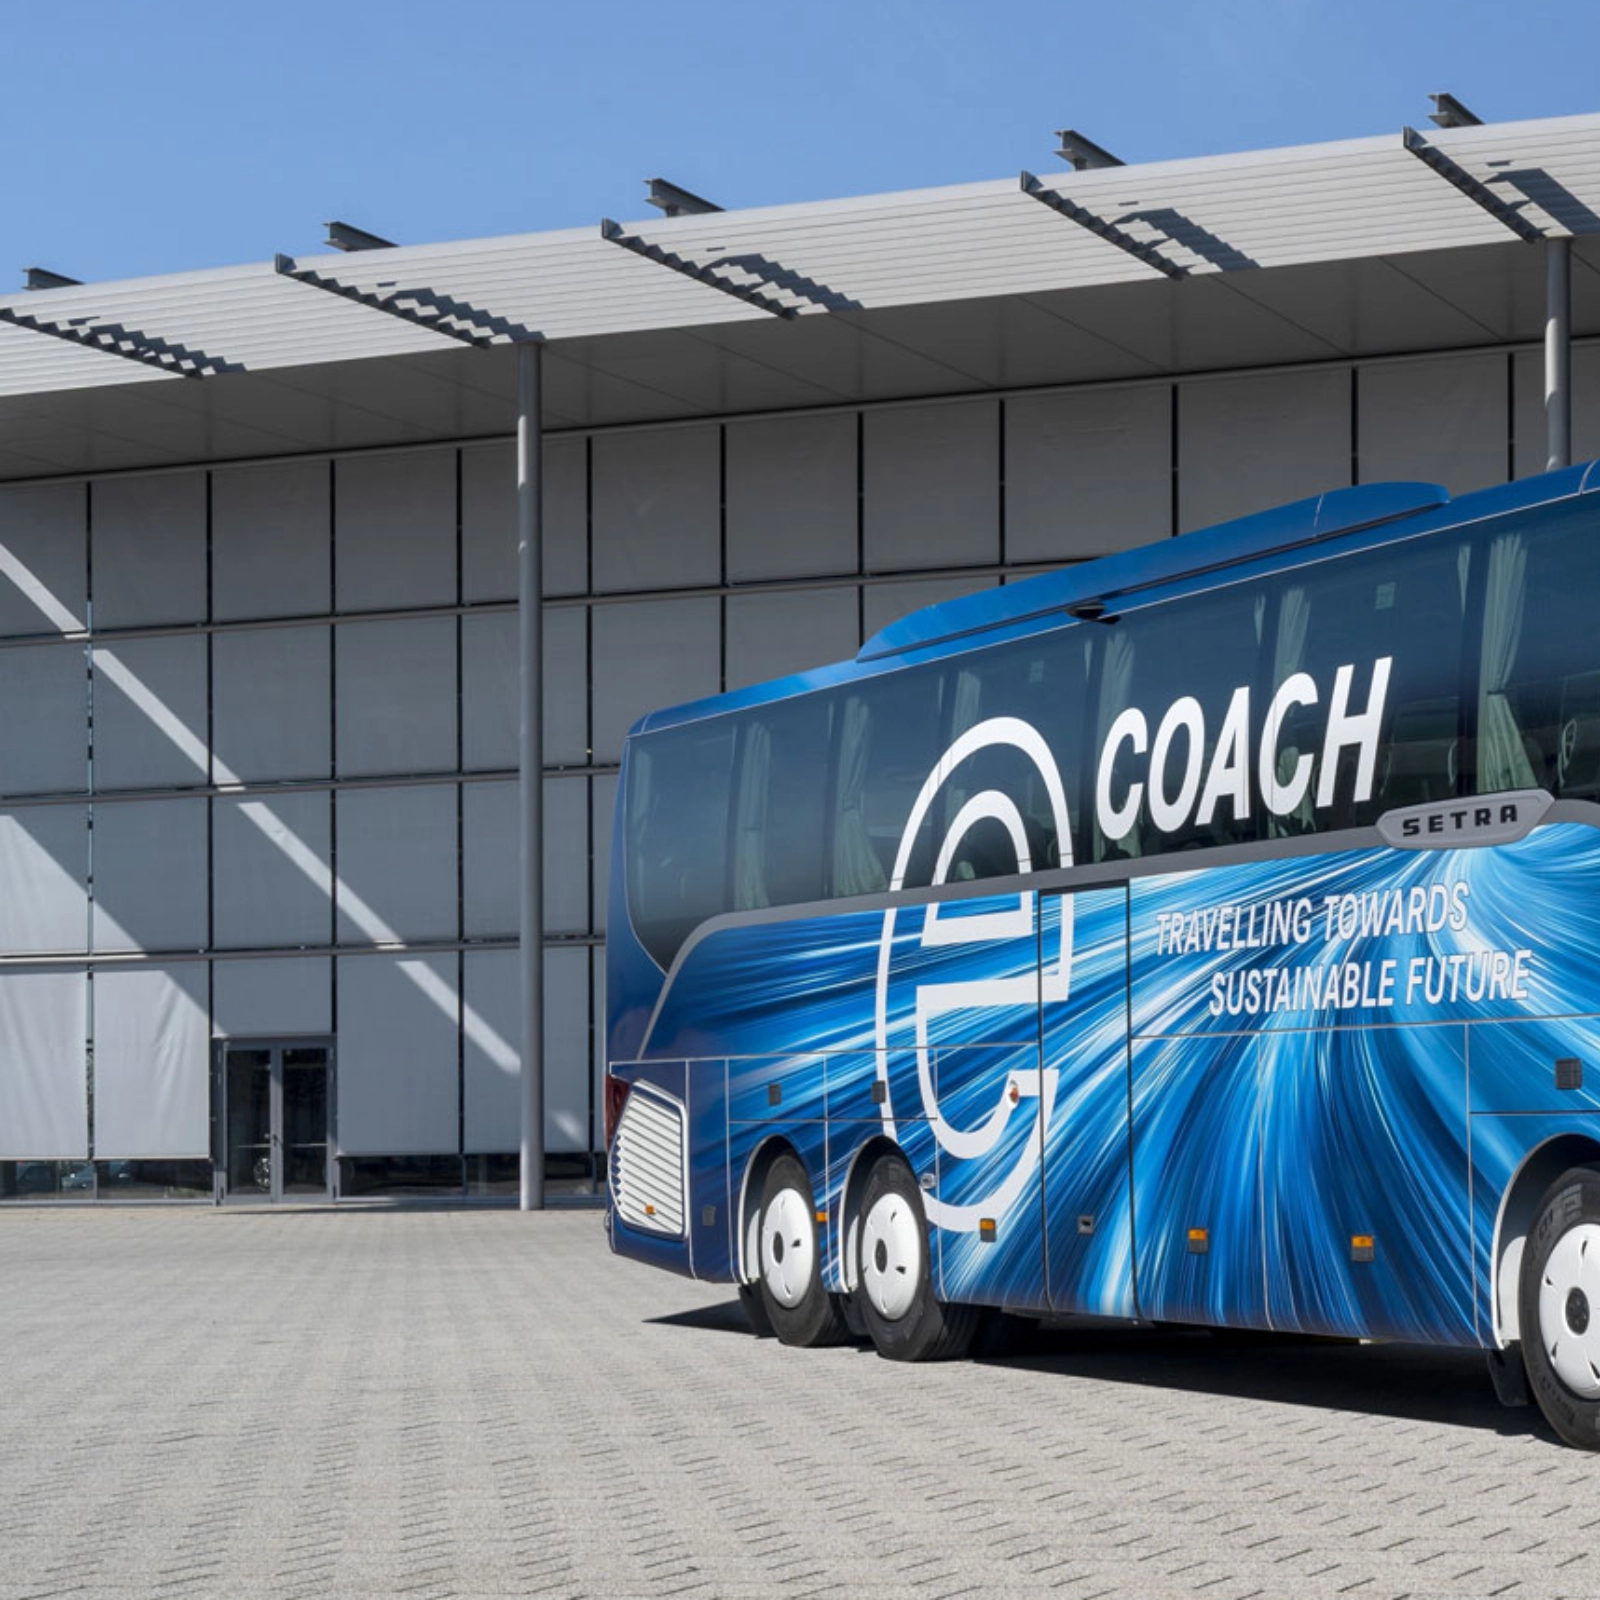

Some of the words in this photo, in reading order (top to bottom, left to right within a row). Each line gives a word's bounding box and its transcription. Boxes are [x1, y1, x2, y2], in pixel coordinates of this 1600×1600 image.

[1096, 656, 1392, 840] COACH
[1402, 804, 1518, 837] SETRA
[1155, 898, 1312, 956] TRAVELLING
[1324, 881, 1470, 941] TOWARDS
[1209, 958, 1397, 1016] SUSTAINABLE
[1405, 949, 1533, 1006] FUTURE
